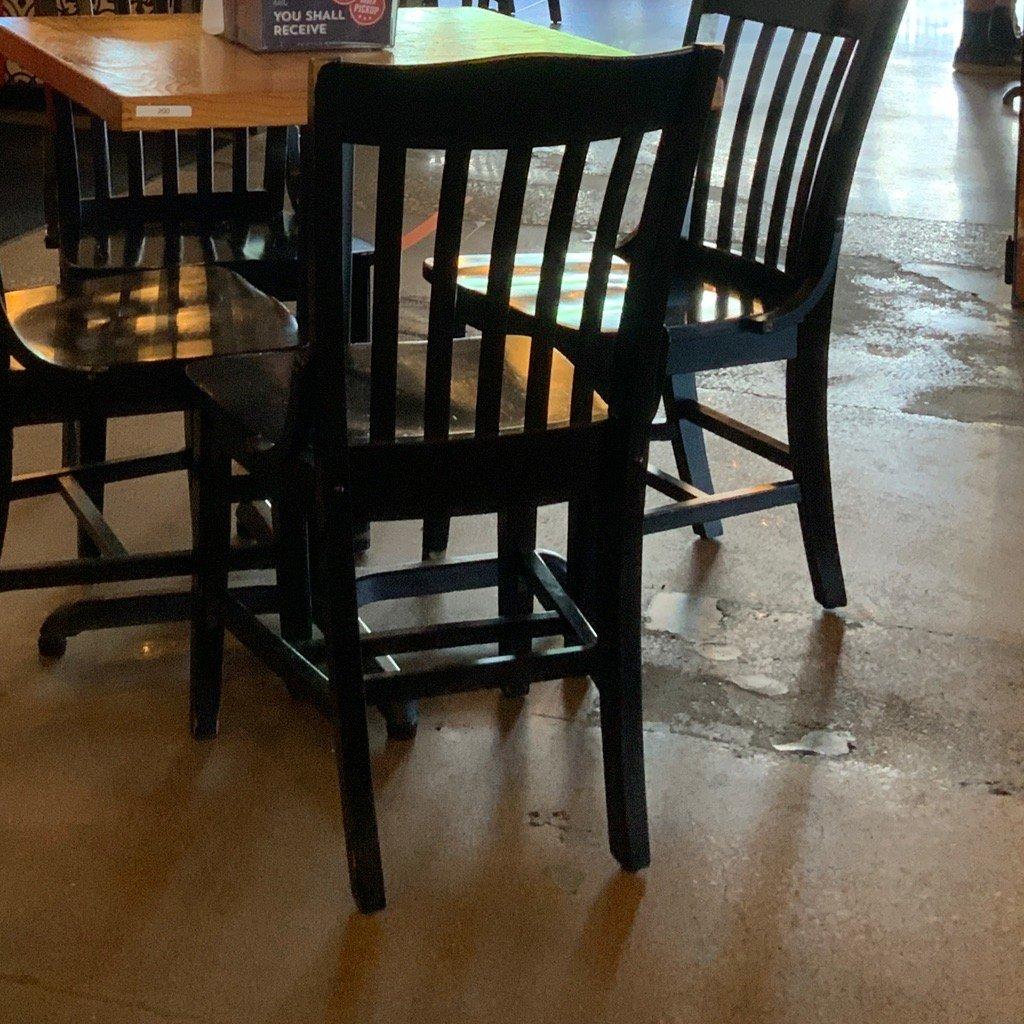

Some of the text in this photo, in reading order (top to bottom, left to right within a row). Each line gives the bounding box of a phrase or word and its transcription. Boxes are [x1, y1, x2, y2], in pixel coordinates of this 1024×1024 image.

[354, 3, 379, 15] PICKUP
[273, 9, 345, 22] YOU SHALL
[273, 23, 327, 35] RECEIVE
